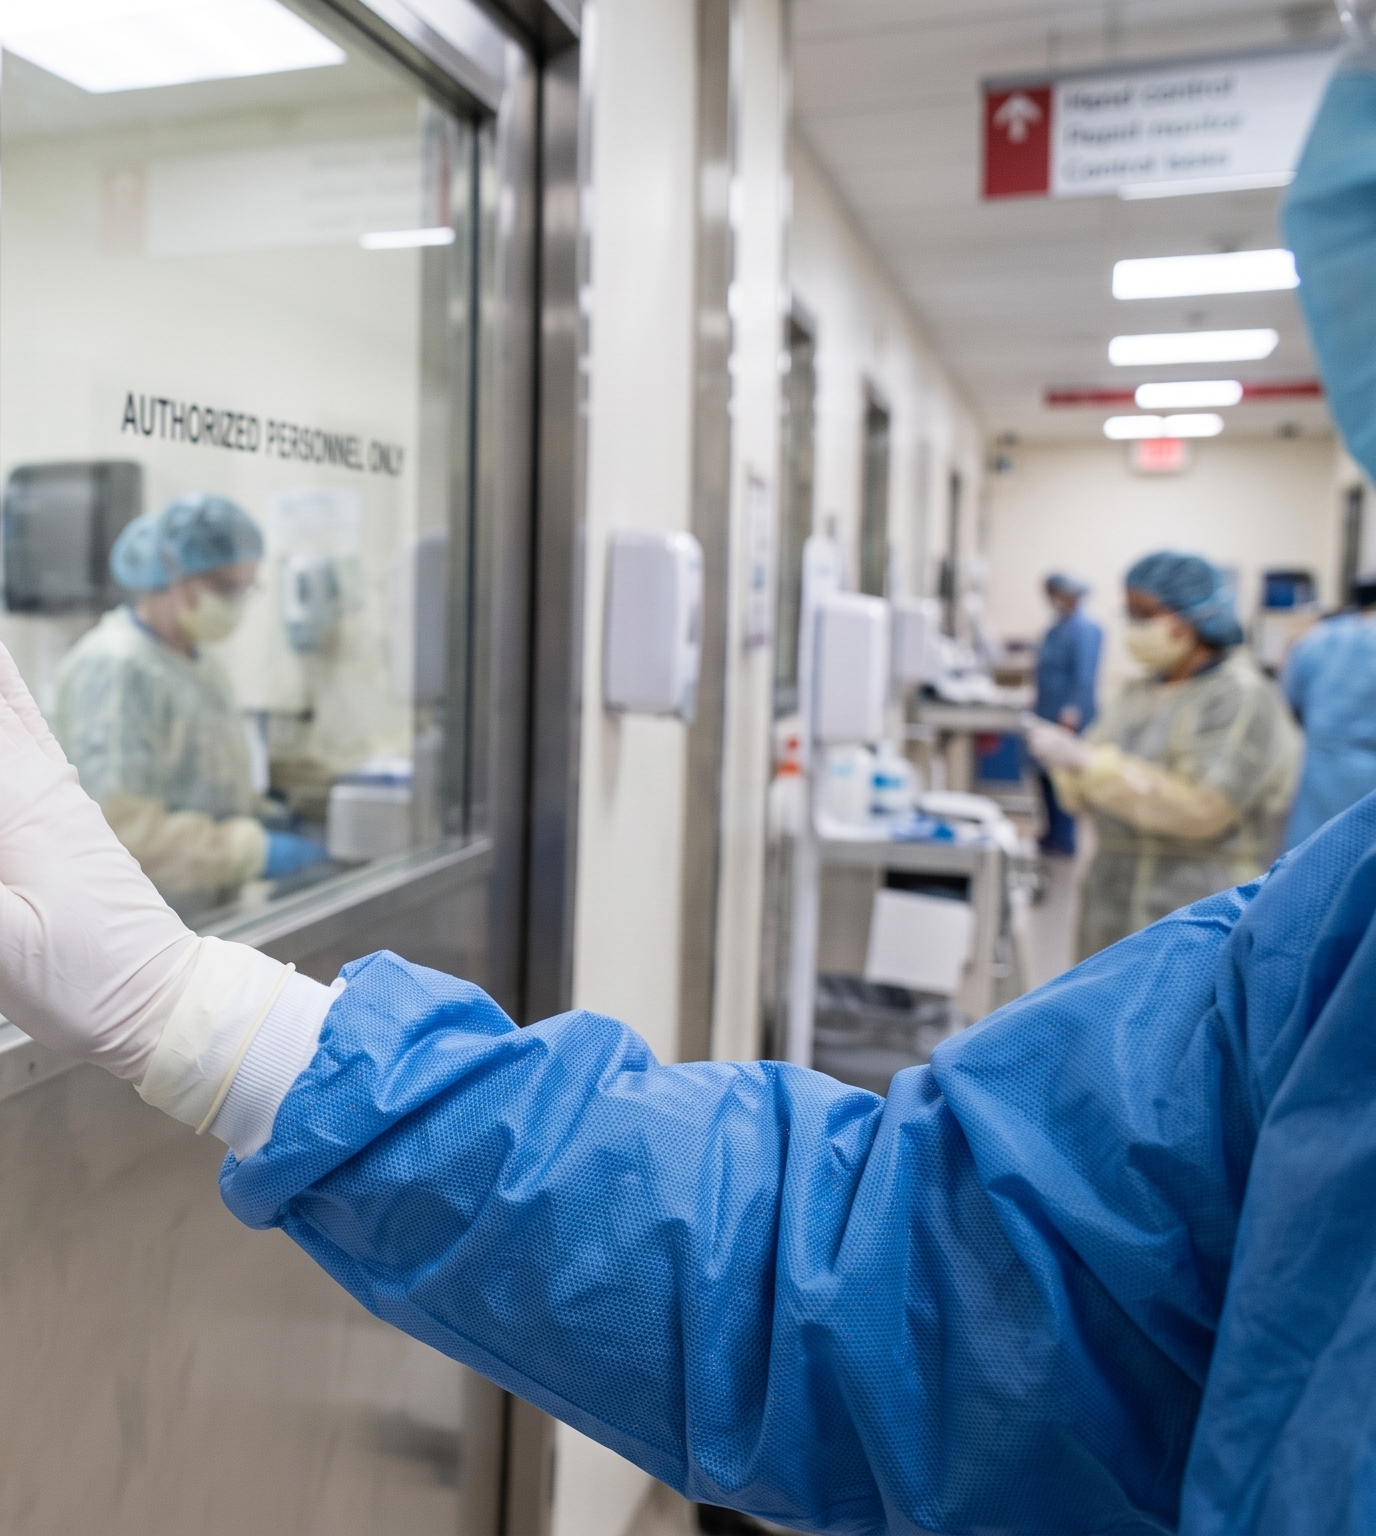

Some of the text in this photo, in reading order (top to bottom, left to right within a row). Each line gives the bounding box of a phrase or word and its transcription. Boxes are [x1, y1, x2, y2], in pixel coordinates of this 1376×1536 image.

[122, 391, 405, 477] AUTHORIZED PERSONNEL ONLY
